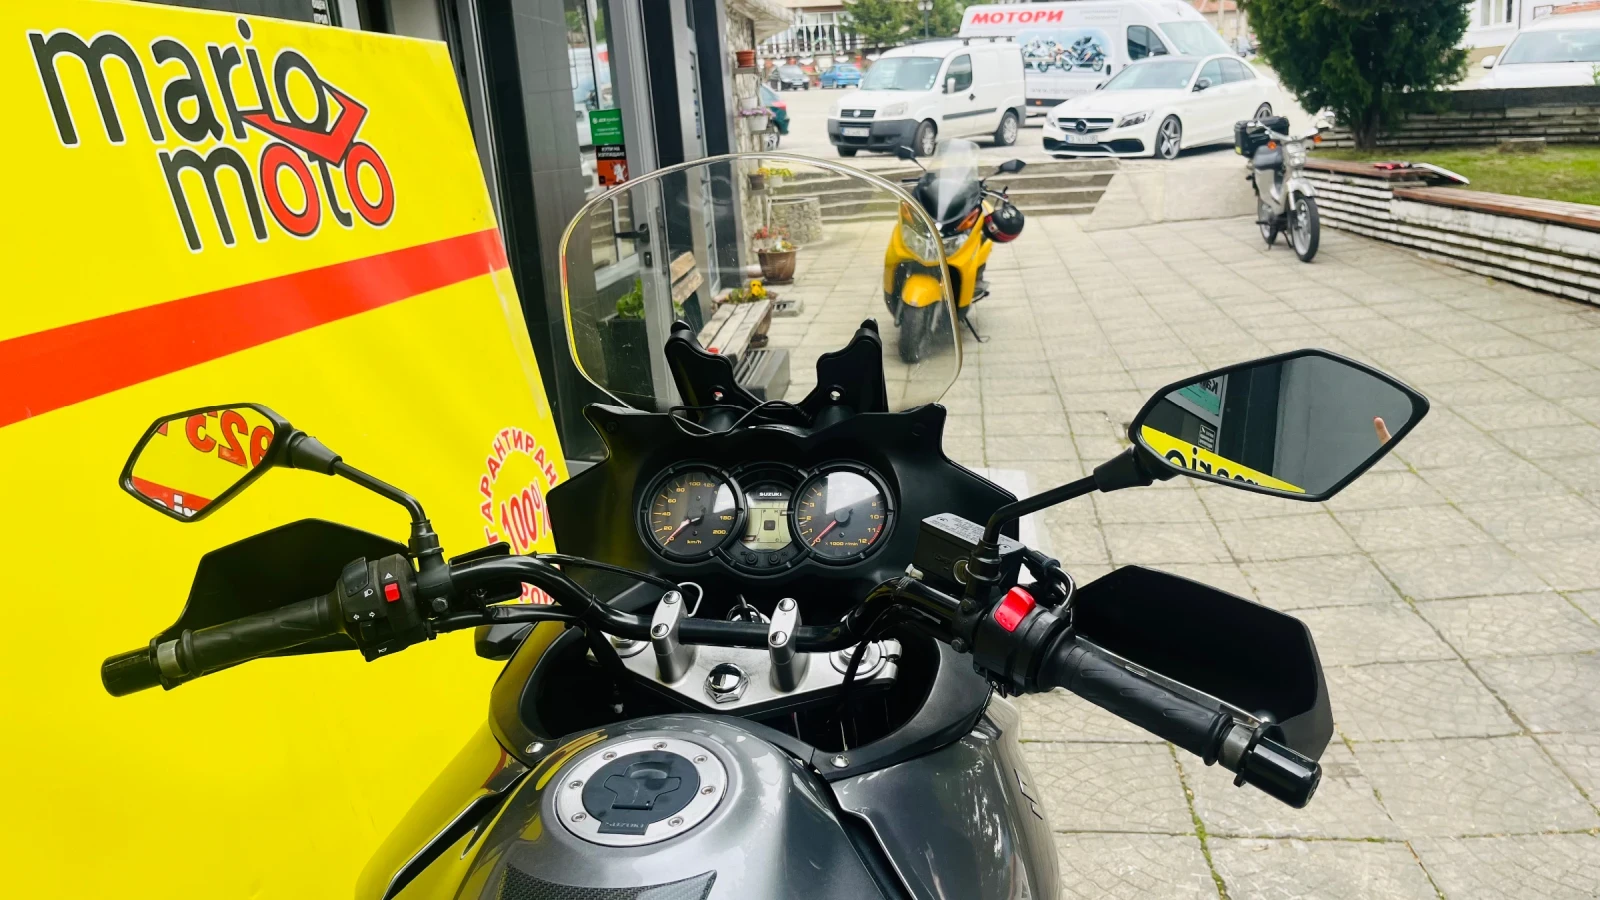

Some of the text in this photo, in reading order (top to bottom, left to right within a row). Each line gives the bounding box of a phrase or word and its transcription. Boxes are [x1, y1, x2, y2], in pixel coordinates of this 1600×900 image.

[970, 9, 1065, 25] МОТОРИ
[27, 18, 329, 145] mario
[158, 141, 395, 251] moto
[500, 477, 553, 556] 100%
